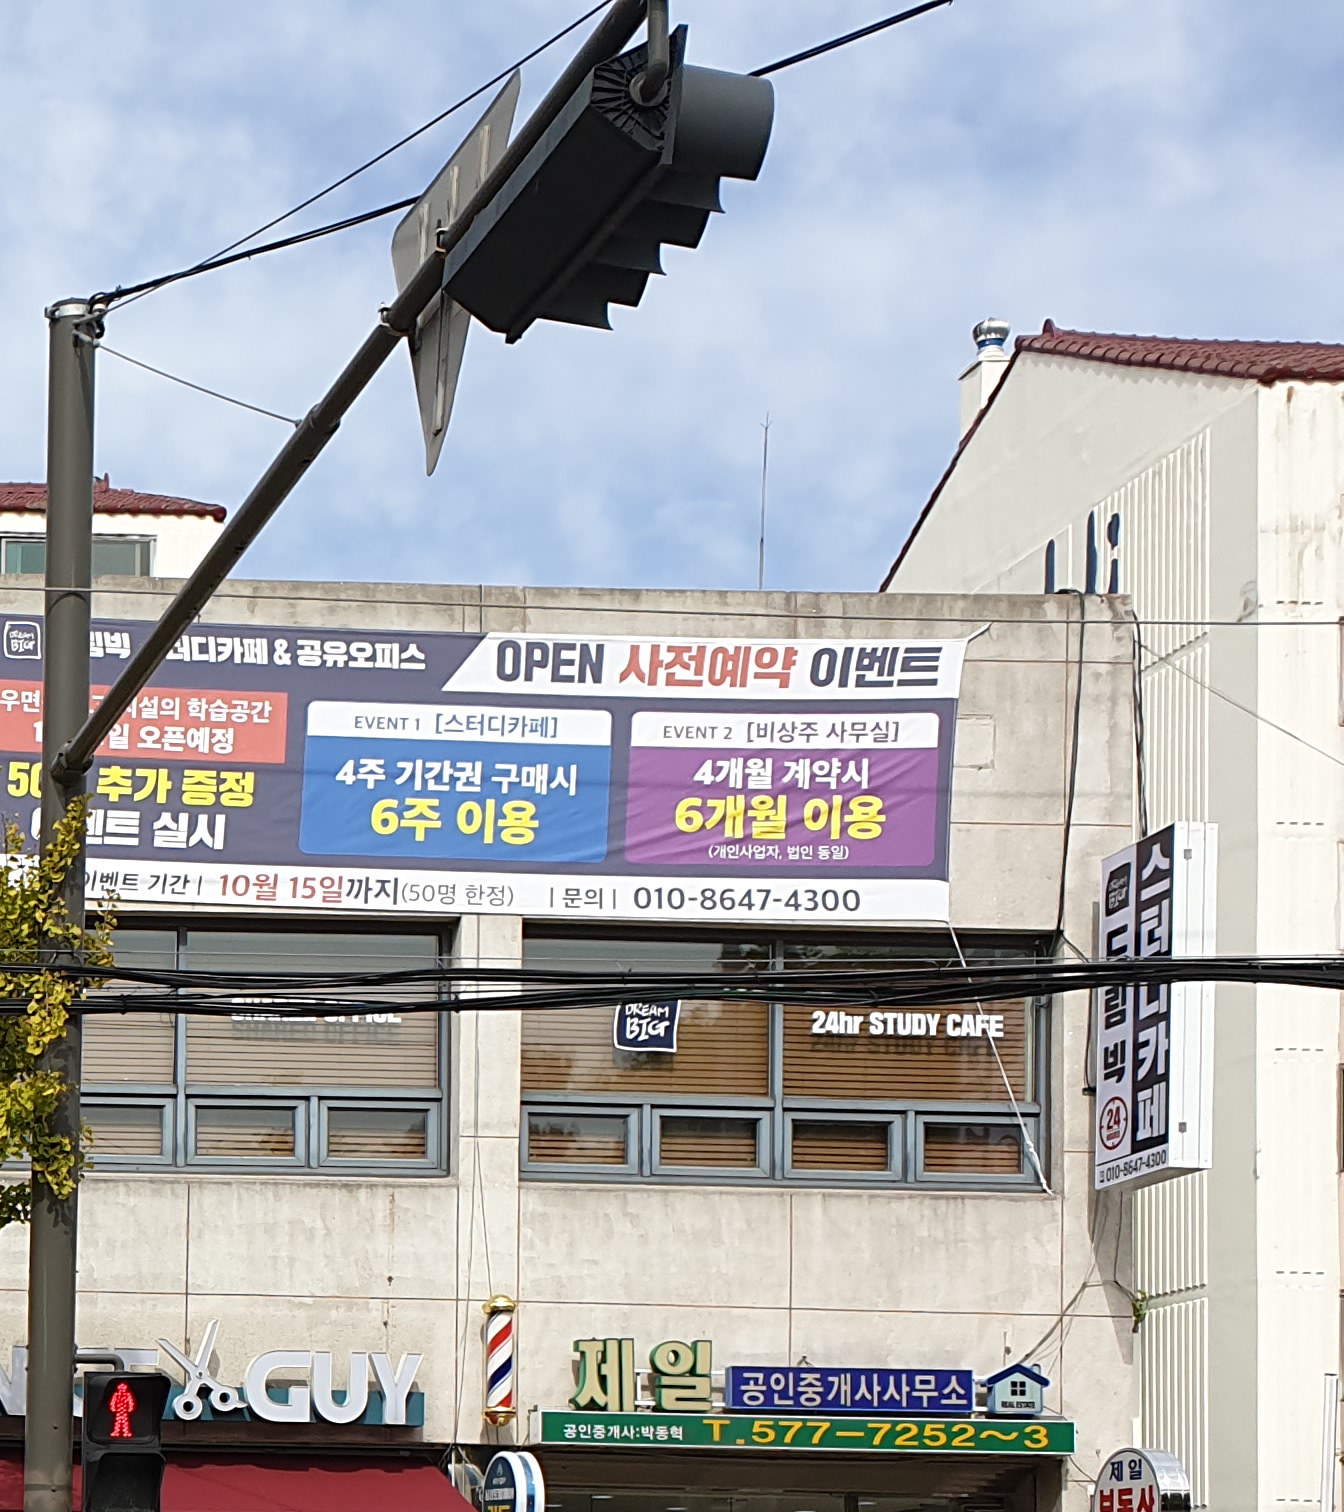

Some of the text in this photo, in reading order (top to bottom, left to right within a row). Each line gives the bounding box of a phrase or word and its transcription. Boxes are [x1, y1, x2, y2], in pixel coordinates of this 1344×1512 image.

[10, 639, 36, 653] BIG
[166, 634, 426, 671] 터디카페 & 공유오피스
[496, 640, 943, 689] OPEN 사전예약 이벤트
[187, 697, 273, 724] 학습공간
[354, 715, 411, 731] EVENT
[434, 712, 559, 739] [스터디카페]
[663, 720, 900, 745] EVENT 2 [비상주 사무실]
[137, 727, 235, 754] 오픈예정
[96, 766, 256, 808] 추가 증정
[335, 758, 577, 796] 4주 기간권 구매시
[694, 757, 870, 790] 4개월 계약시
[152, 811, 227, 850] 실시
[370, 798, 540, 845] 6주 이용
[675, 795, 887, 841] 6개월 이용
[786, 845, 814, 862] 법인
[148, 873, 190, 895] 기간
[219, 873, 279, 901] 10월
[465, 885, 515, 909] 한정)
[561, 886, 861, 913] 문의 010-8647-4300
[625, 1003, 670, 1020] DREAM
[811, 1010, 1005, 1038] 24hr STUDY CAFE
[625, 1016, 671, 1043] BIG
[1106, 1105, 1121, 1131] 24
[244, 1349, 425, 1425] GUY
[572, 1337, 970, 1413] 제일 공인중개사사무소
[1109, 1458, 1143, 1482] 제일
